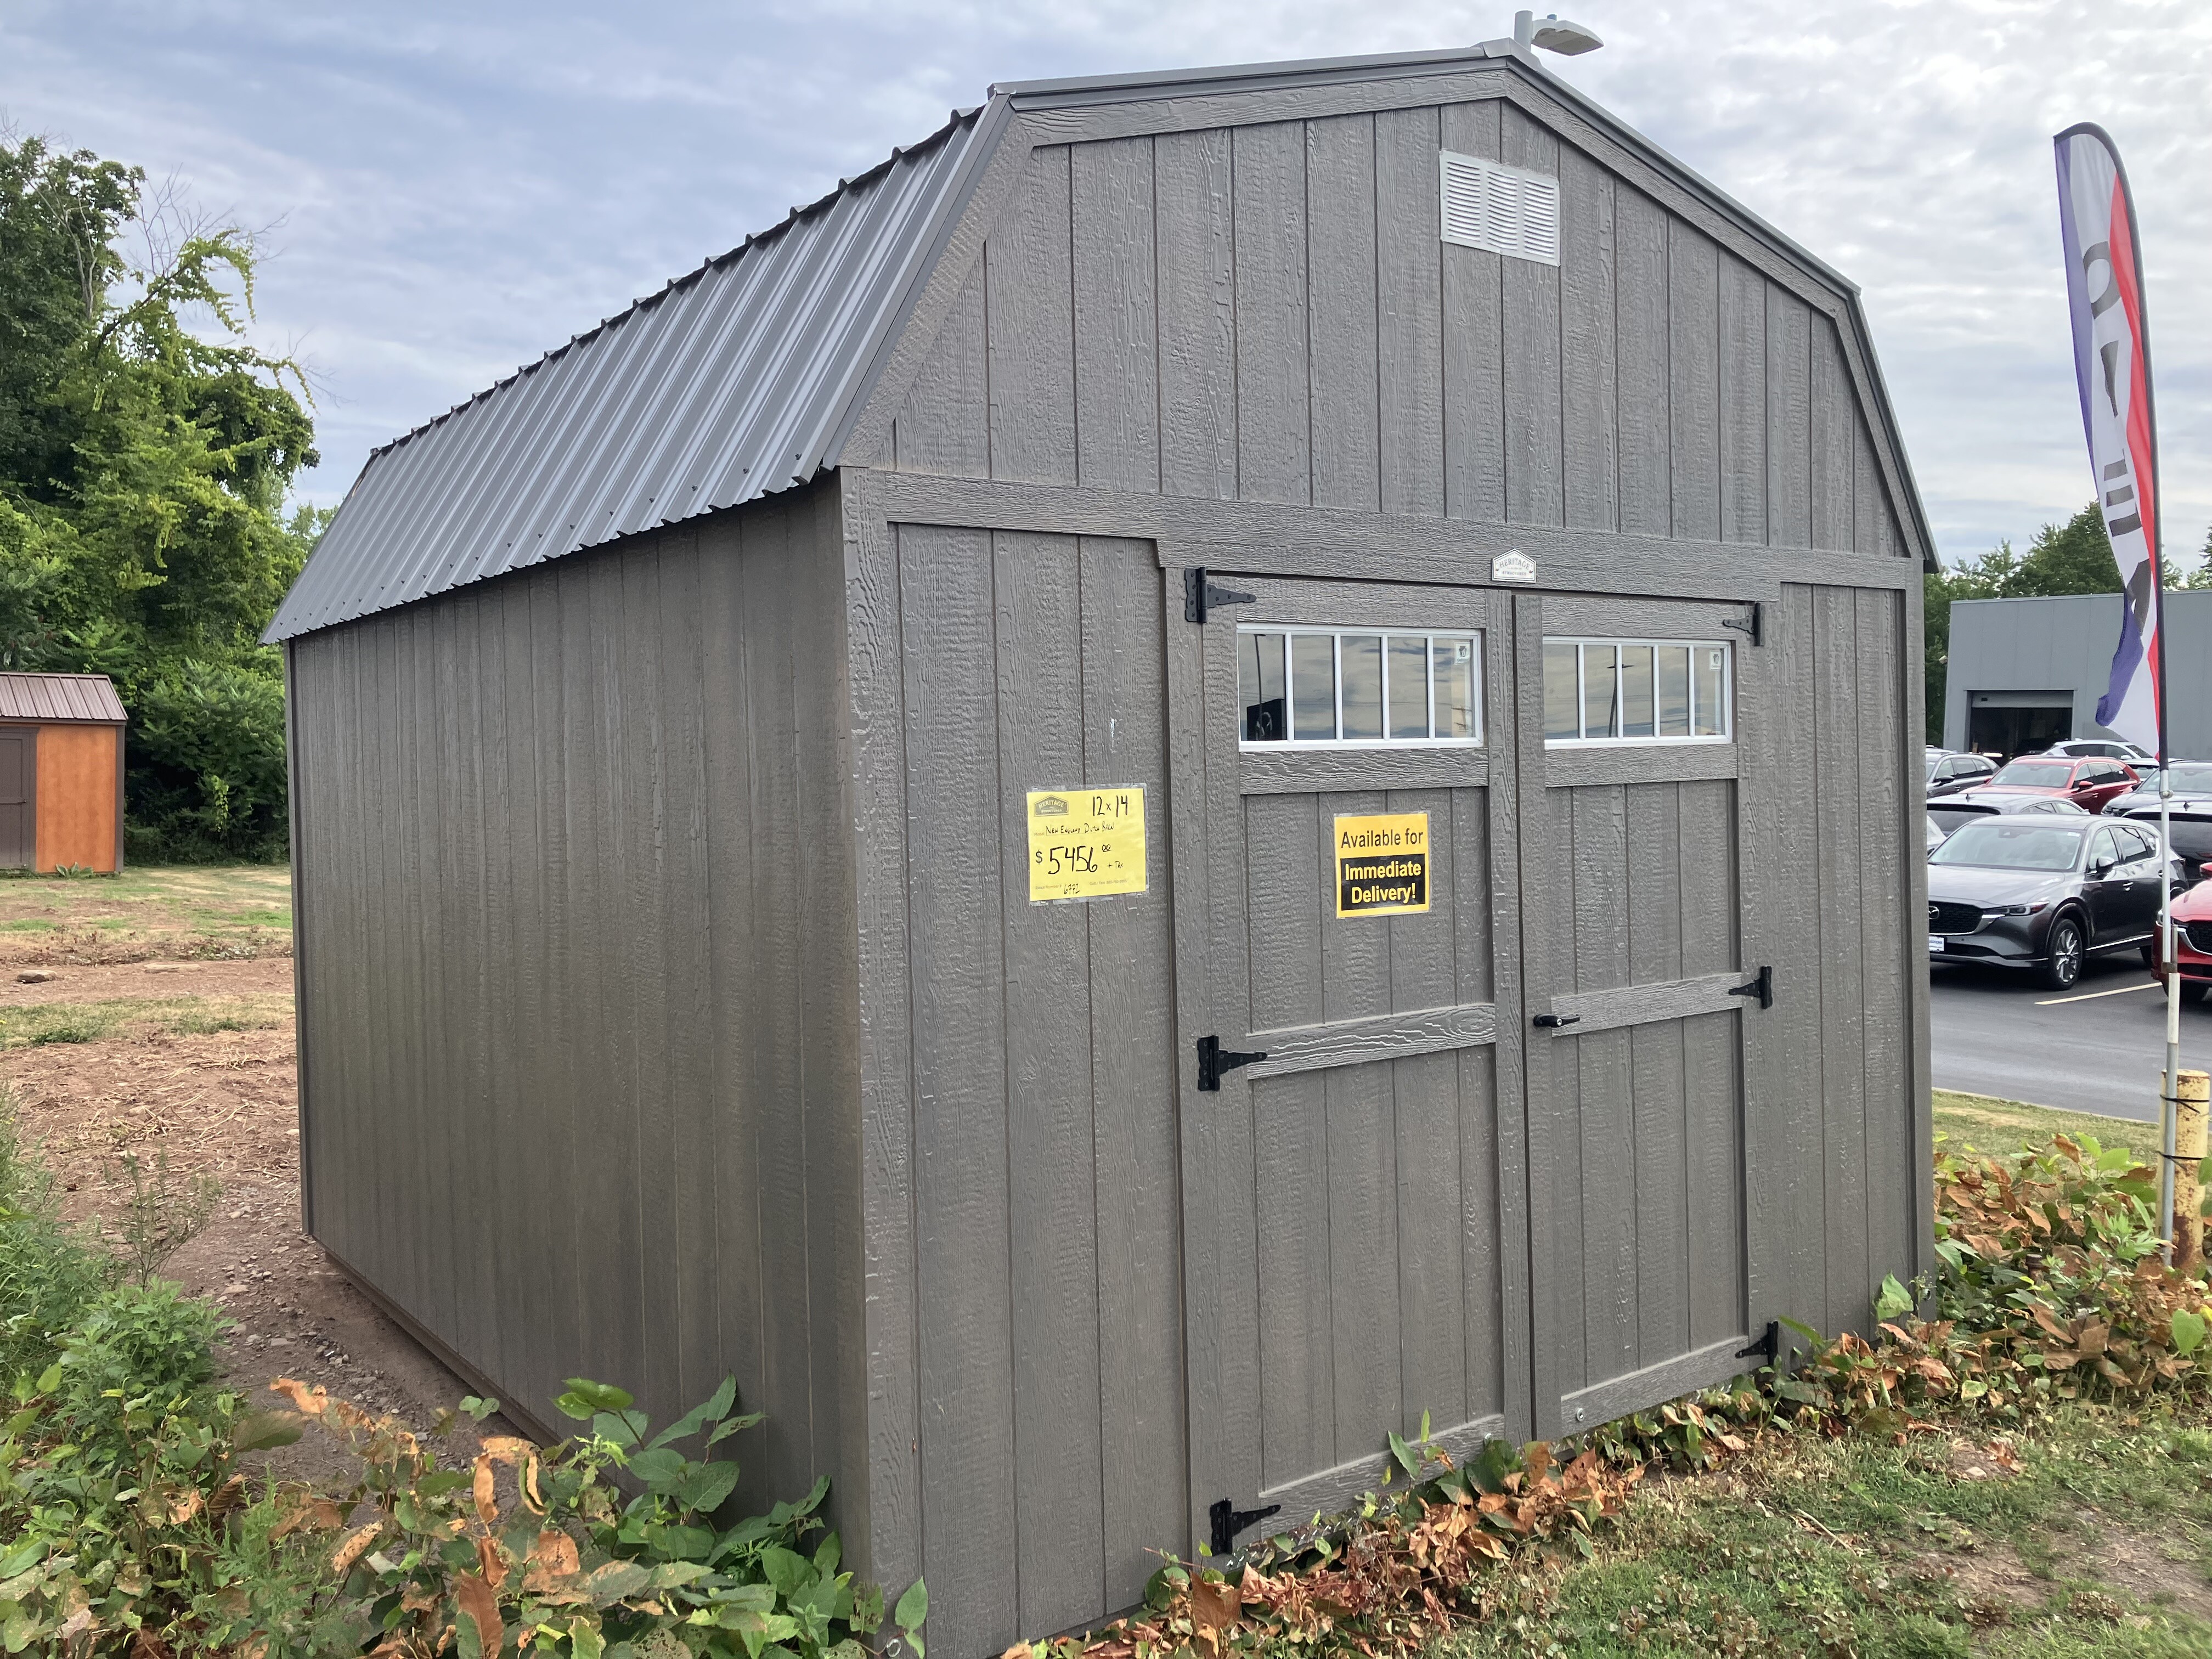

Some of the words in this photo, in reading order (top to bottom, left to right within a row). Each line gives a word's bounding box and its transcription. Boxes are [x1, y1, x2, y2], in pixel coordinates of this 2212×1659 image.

[1499, 558, 1530, 570] HERITAGE
[1038, 800, 1064, 809] HERITAGE
[1093, 796, 1105, 816] 12
[1116, 795, 1128, 817] 14
[1341, 830, 1401, 849] Available
[1405, 828, 1423, 845] for
[1345, 860, 1421, 881] Immediate
[1351, 883, 1416, 904] Delivery!
